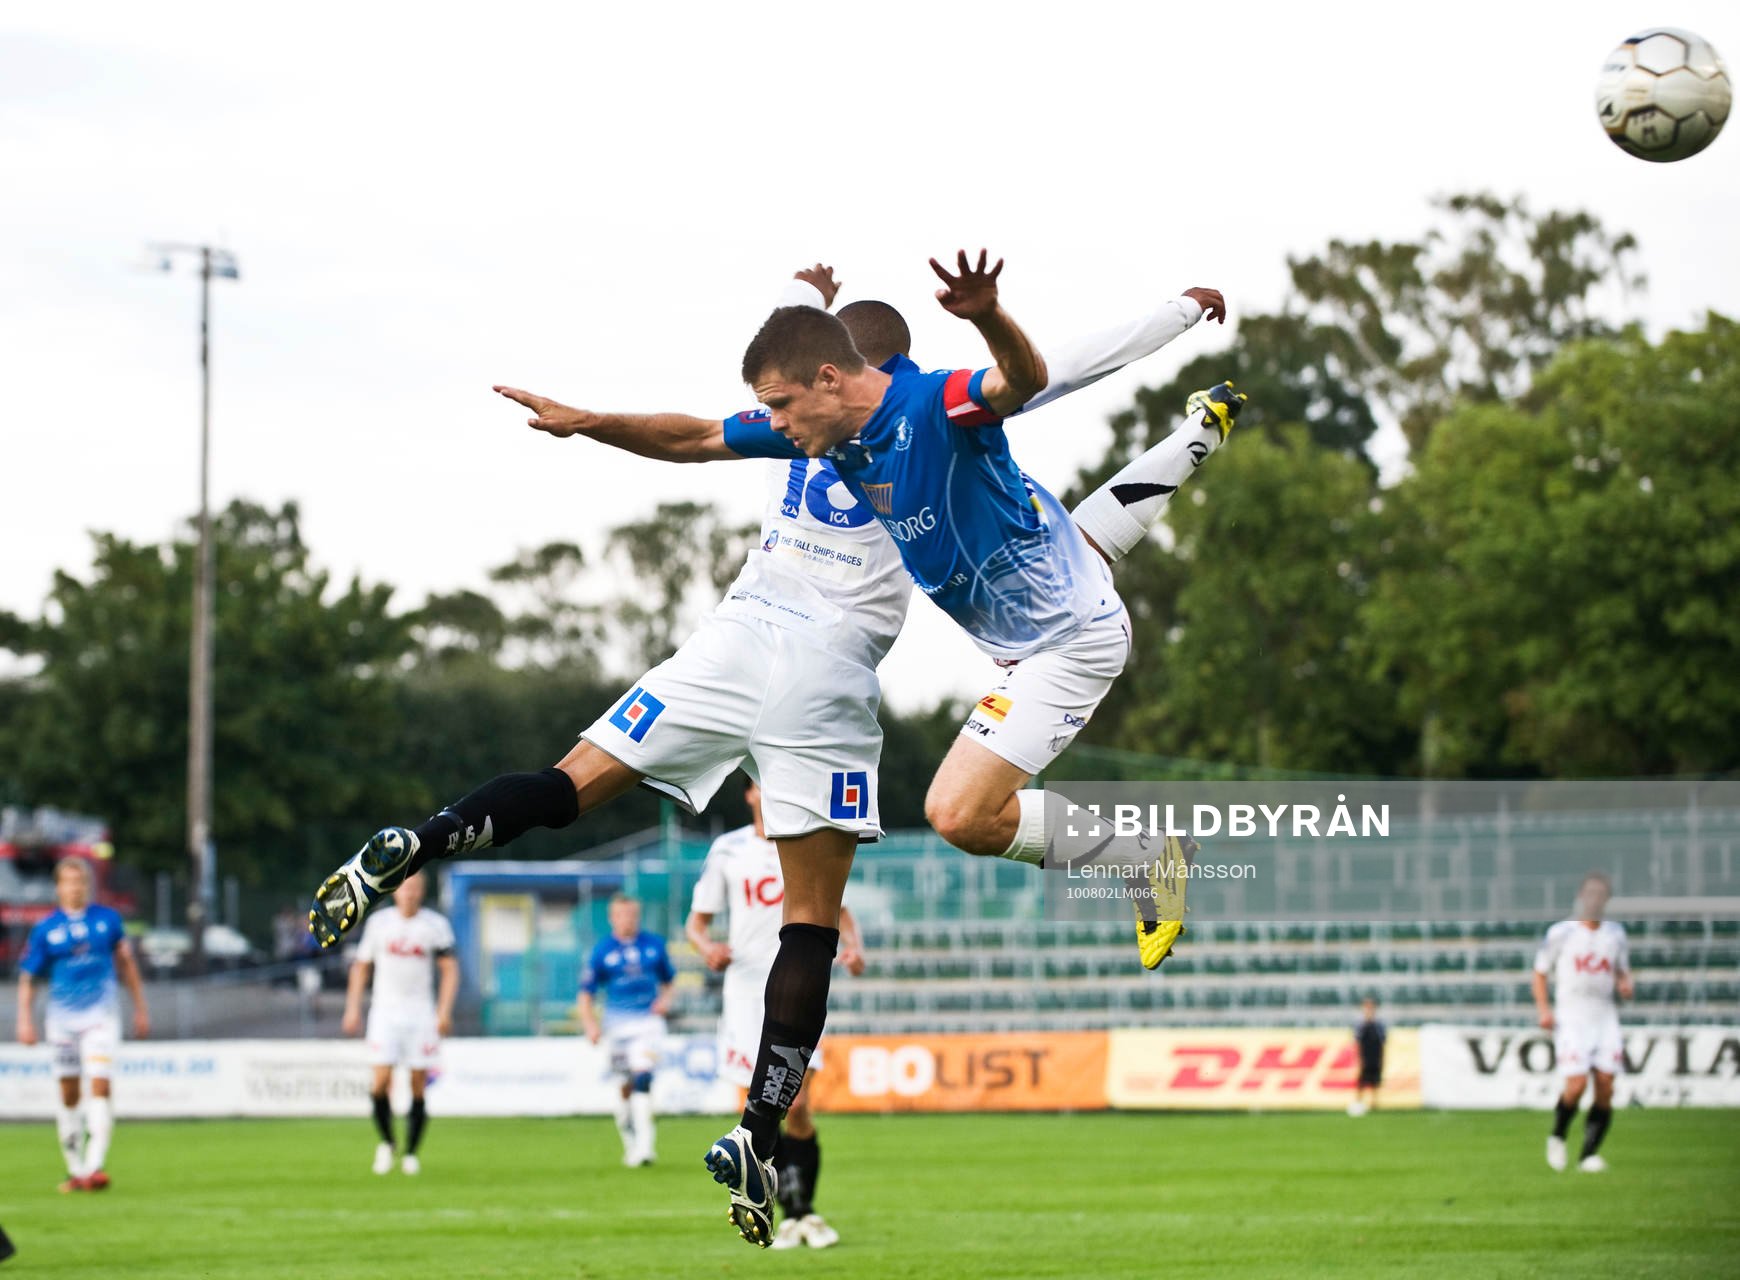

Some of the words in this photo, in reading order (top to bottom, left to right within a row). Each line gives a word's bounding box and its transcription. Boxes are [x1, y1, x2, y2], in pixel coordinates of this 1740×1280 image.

[829, 511, 850, 526] ICA
[781, 536, 793, 546] THE
[793, 539, 812, 552] TALL
[812, 544, 836, 560] SHIPS
[836, 552, 863, 567] RACES
[744, 877, 785, 906] IC
[1574, 953, 1612, 974] ICA
[1464, 1036, 1740, 1076] VOVIA
[761, 1064, 788, 1106] SPORT
